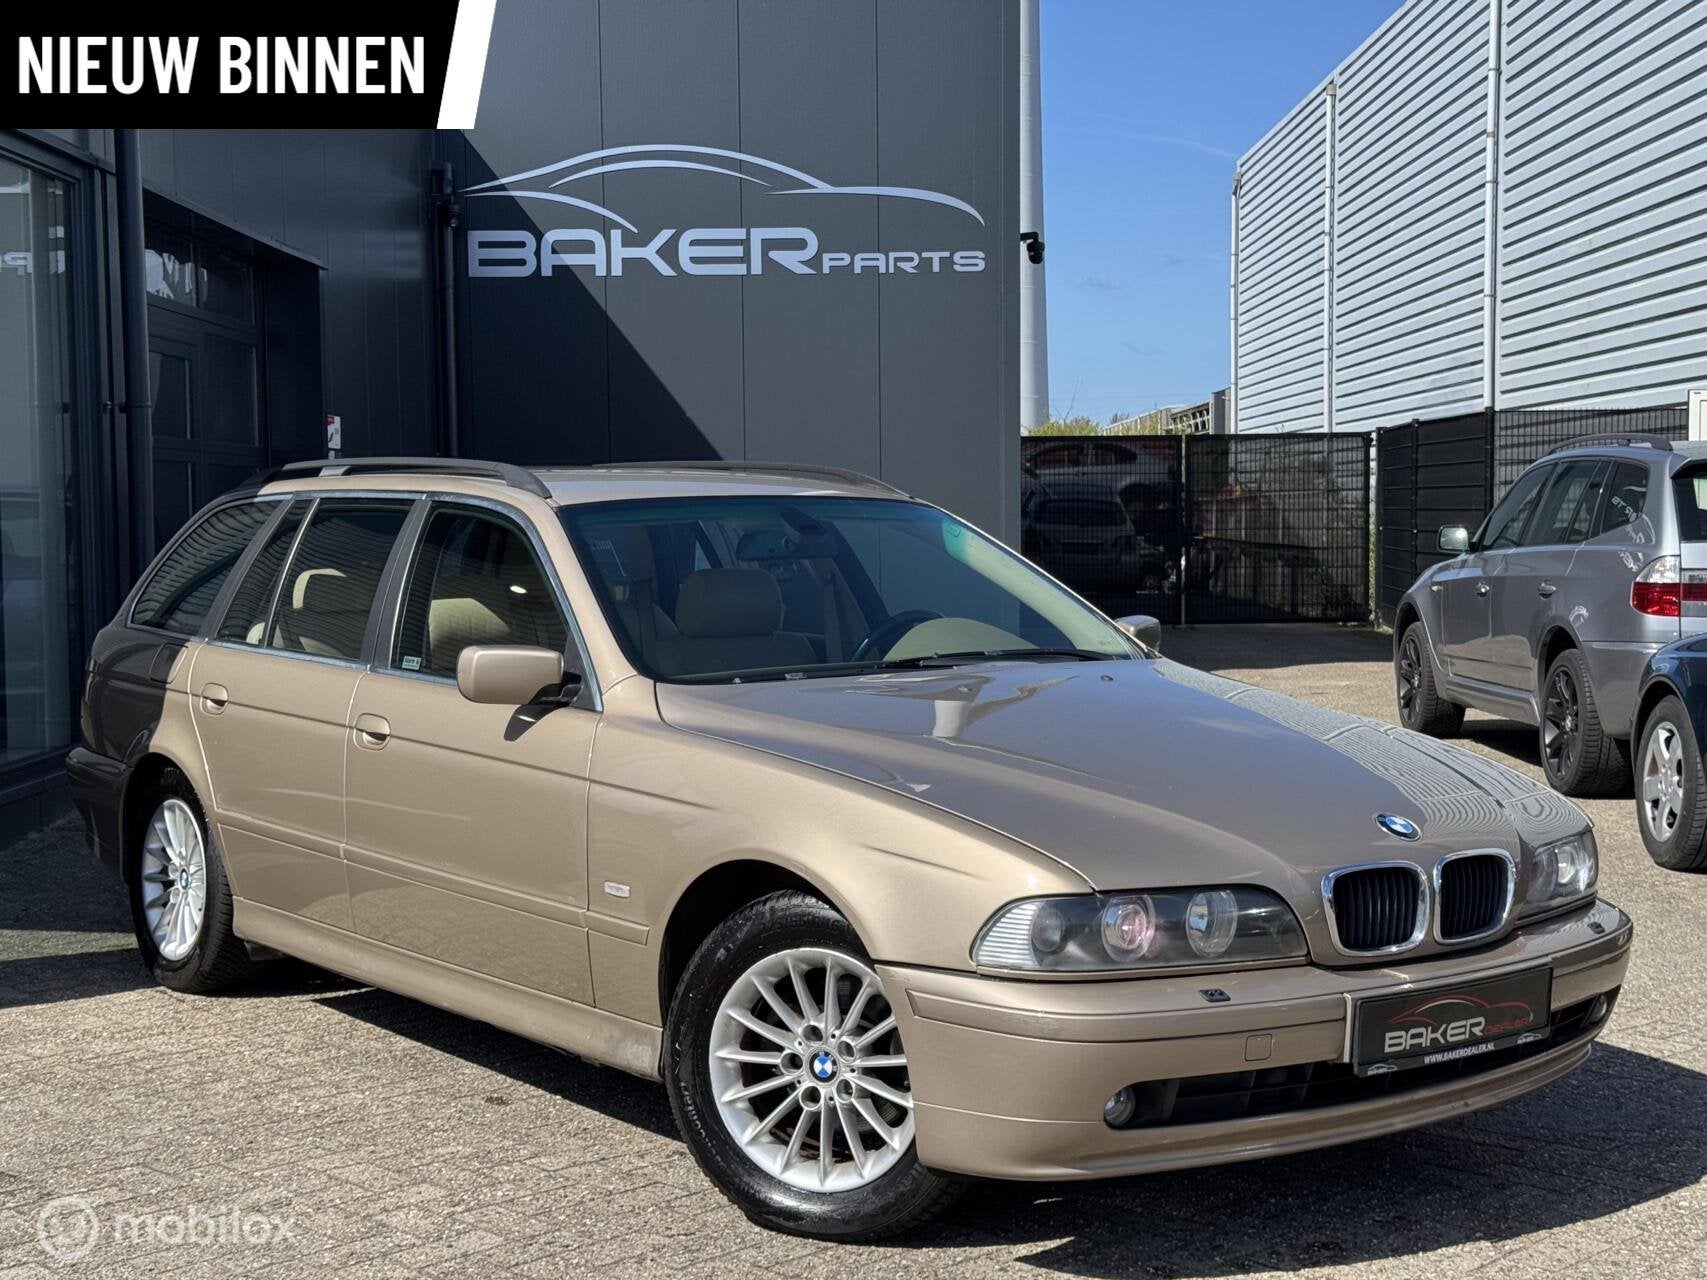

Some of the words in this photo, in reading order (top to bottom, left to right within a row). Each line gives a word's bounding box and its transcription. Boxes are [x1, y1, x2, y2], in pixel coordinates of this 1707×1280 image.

[466, 225, 820, 278] BAKER
[822, 249, 987, 275] PARTS
[1383, 1016, 1486, 1053] BAKER
[1423, 1041, 1496, 1065] WWW.BAKERDEALER.NL
